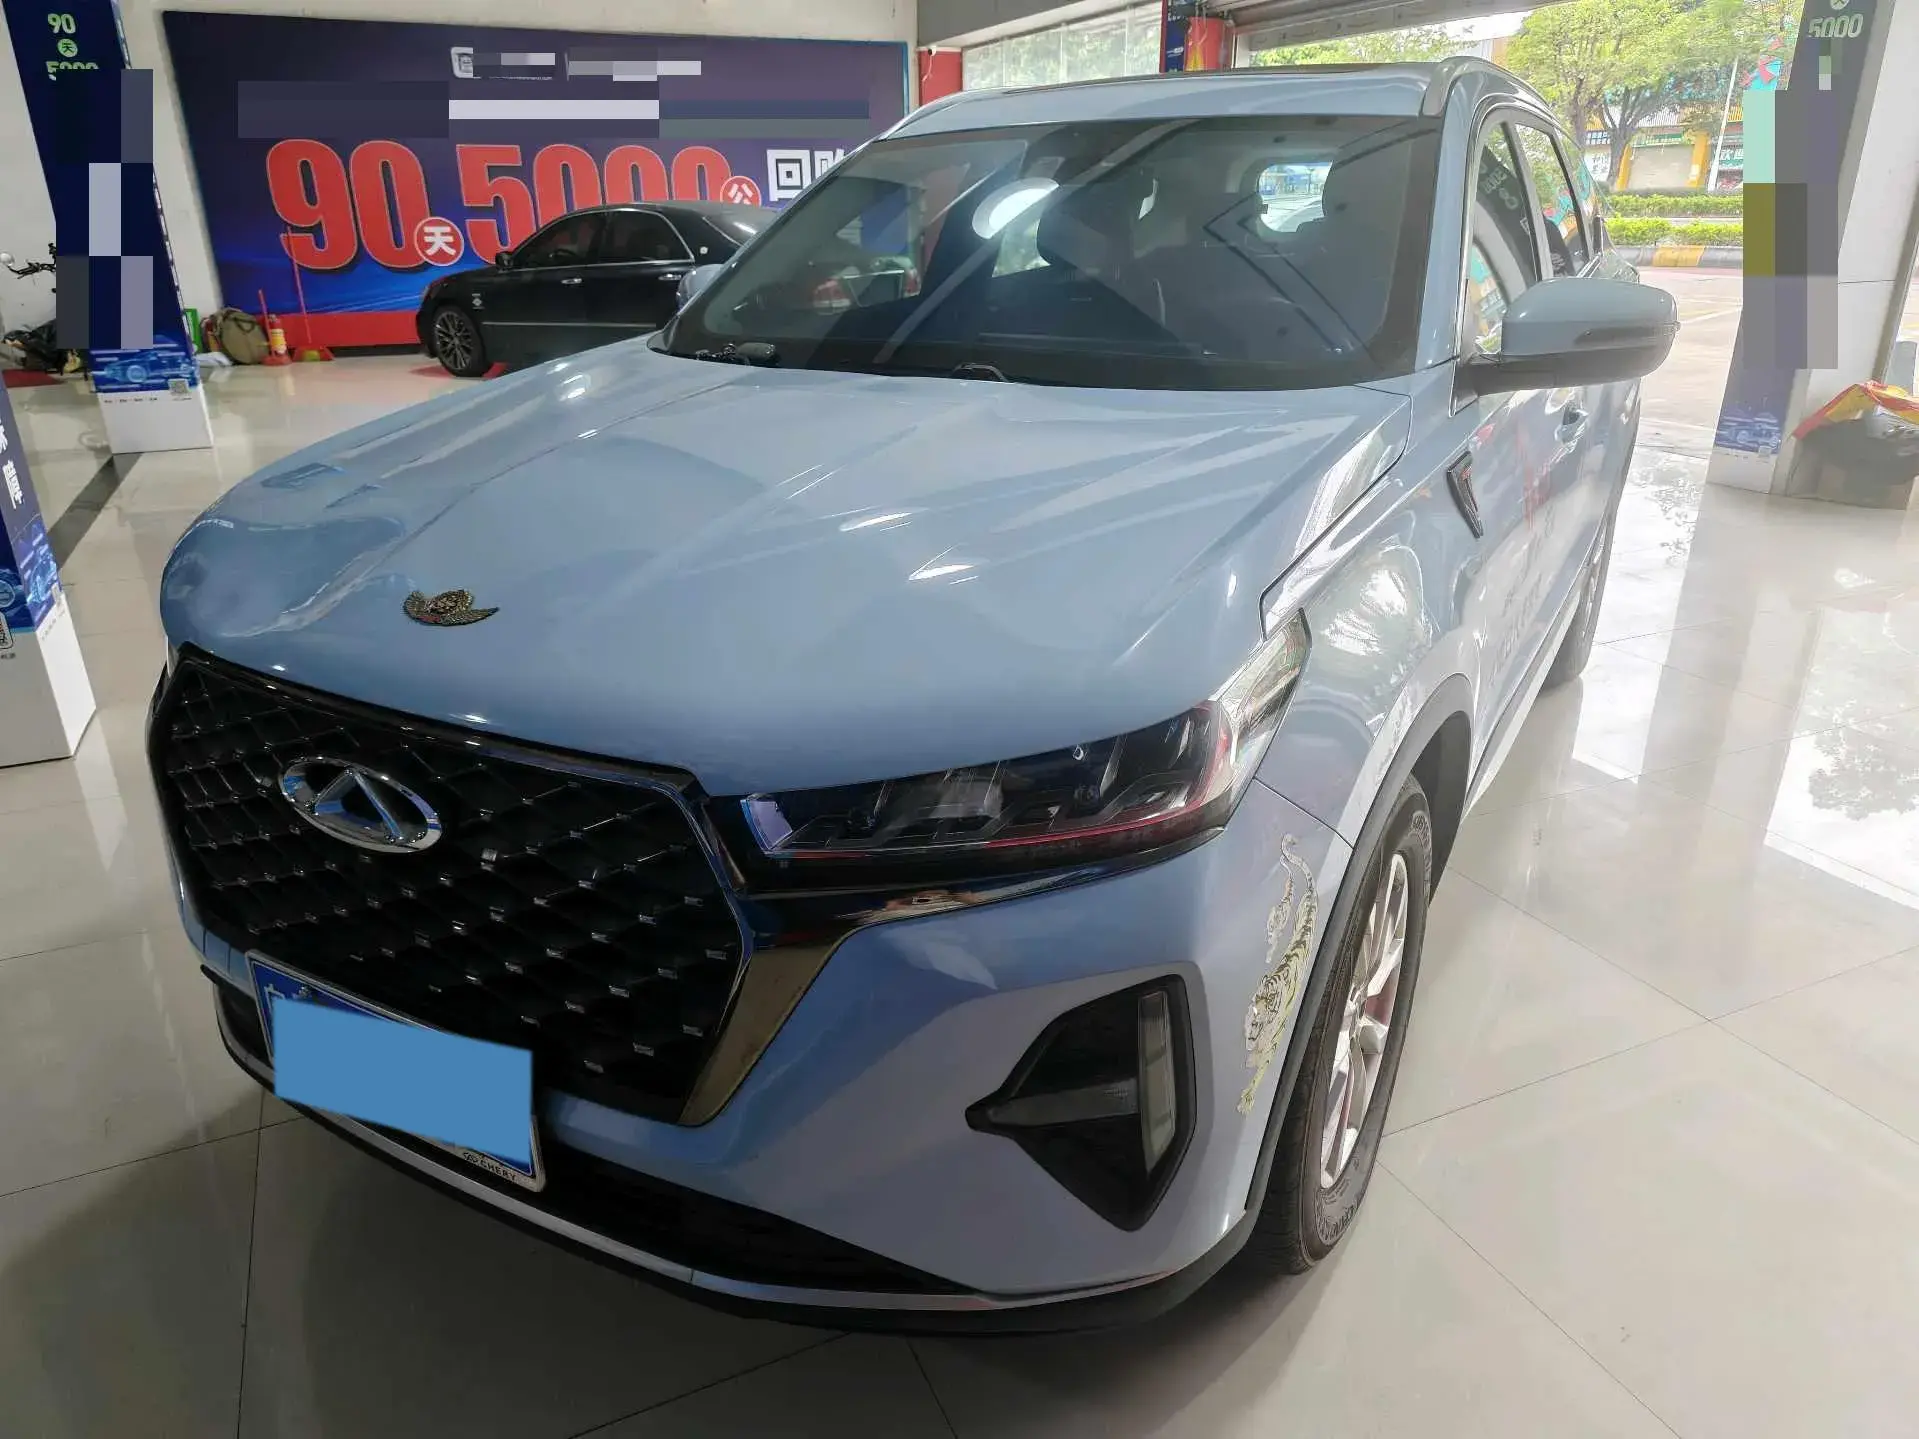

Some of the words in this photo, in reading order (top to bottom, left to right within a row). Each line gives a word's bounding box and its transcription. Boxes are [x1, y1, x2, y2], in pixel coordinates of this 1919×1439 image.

[47, 12, 77, 34] 90
[266, 139, 430, 269] 90
[422, 225, 457, 256] 天
